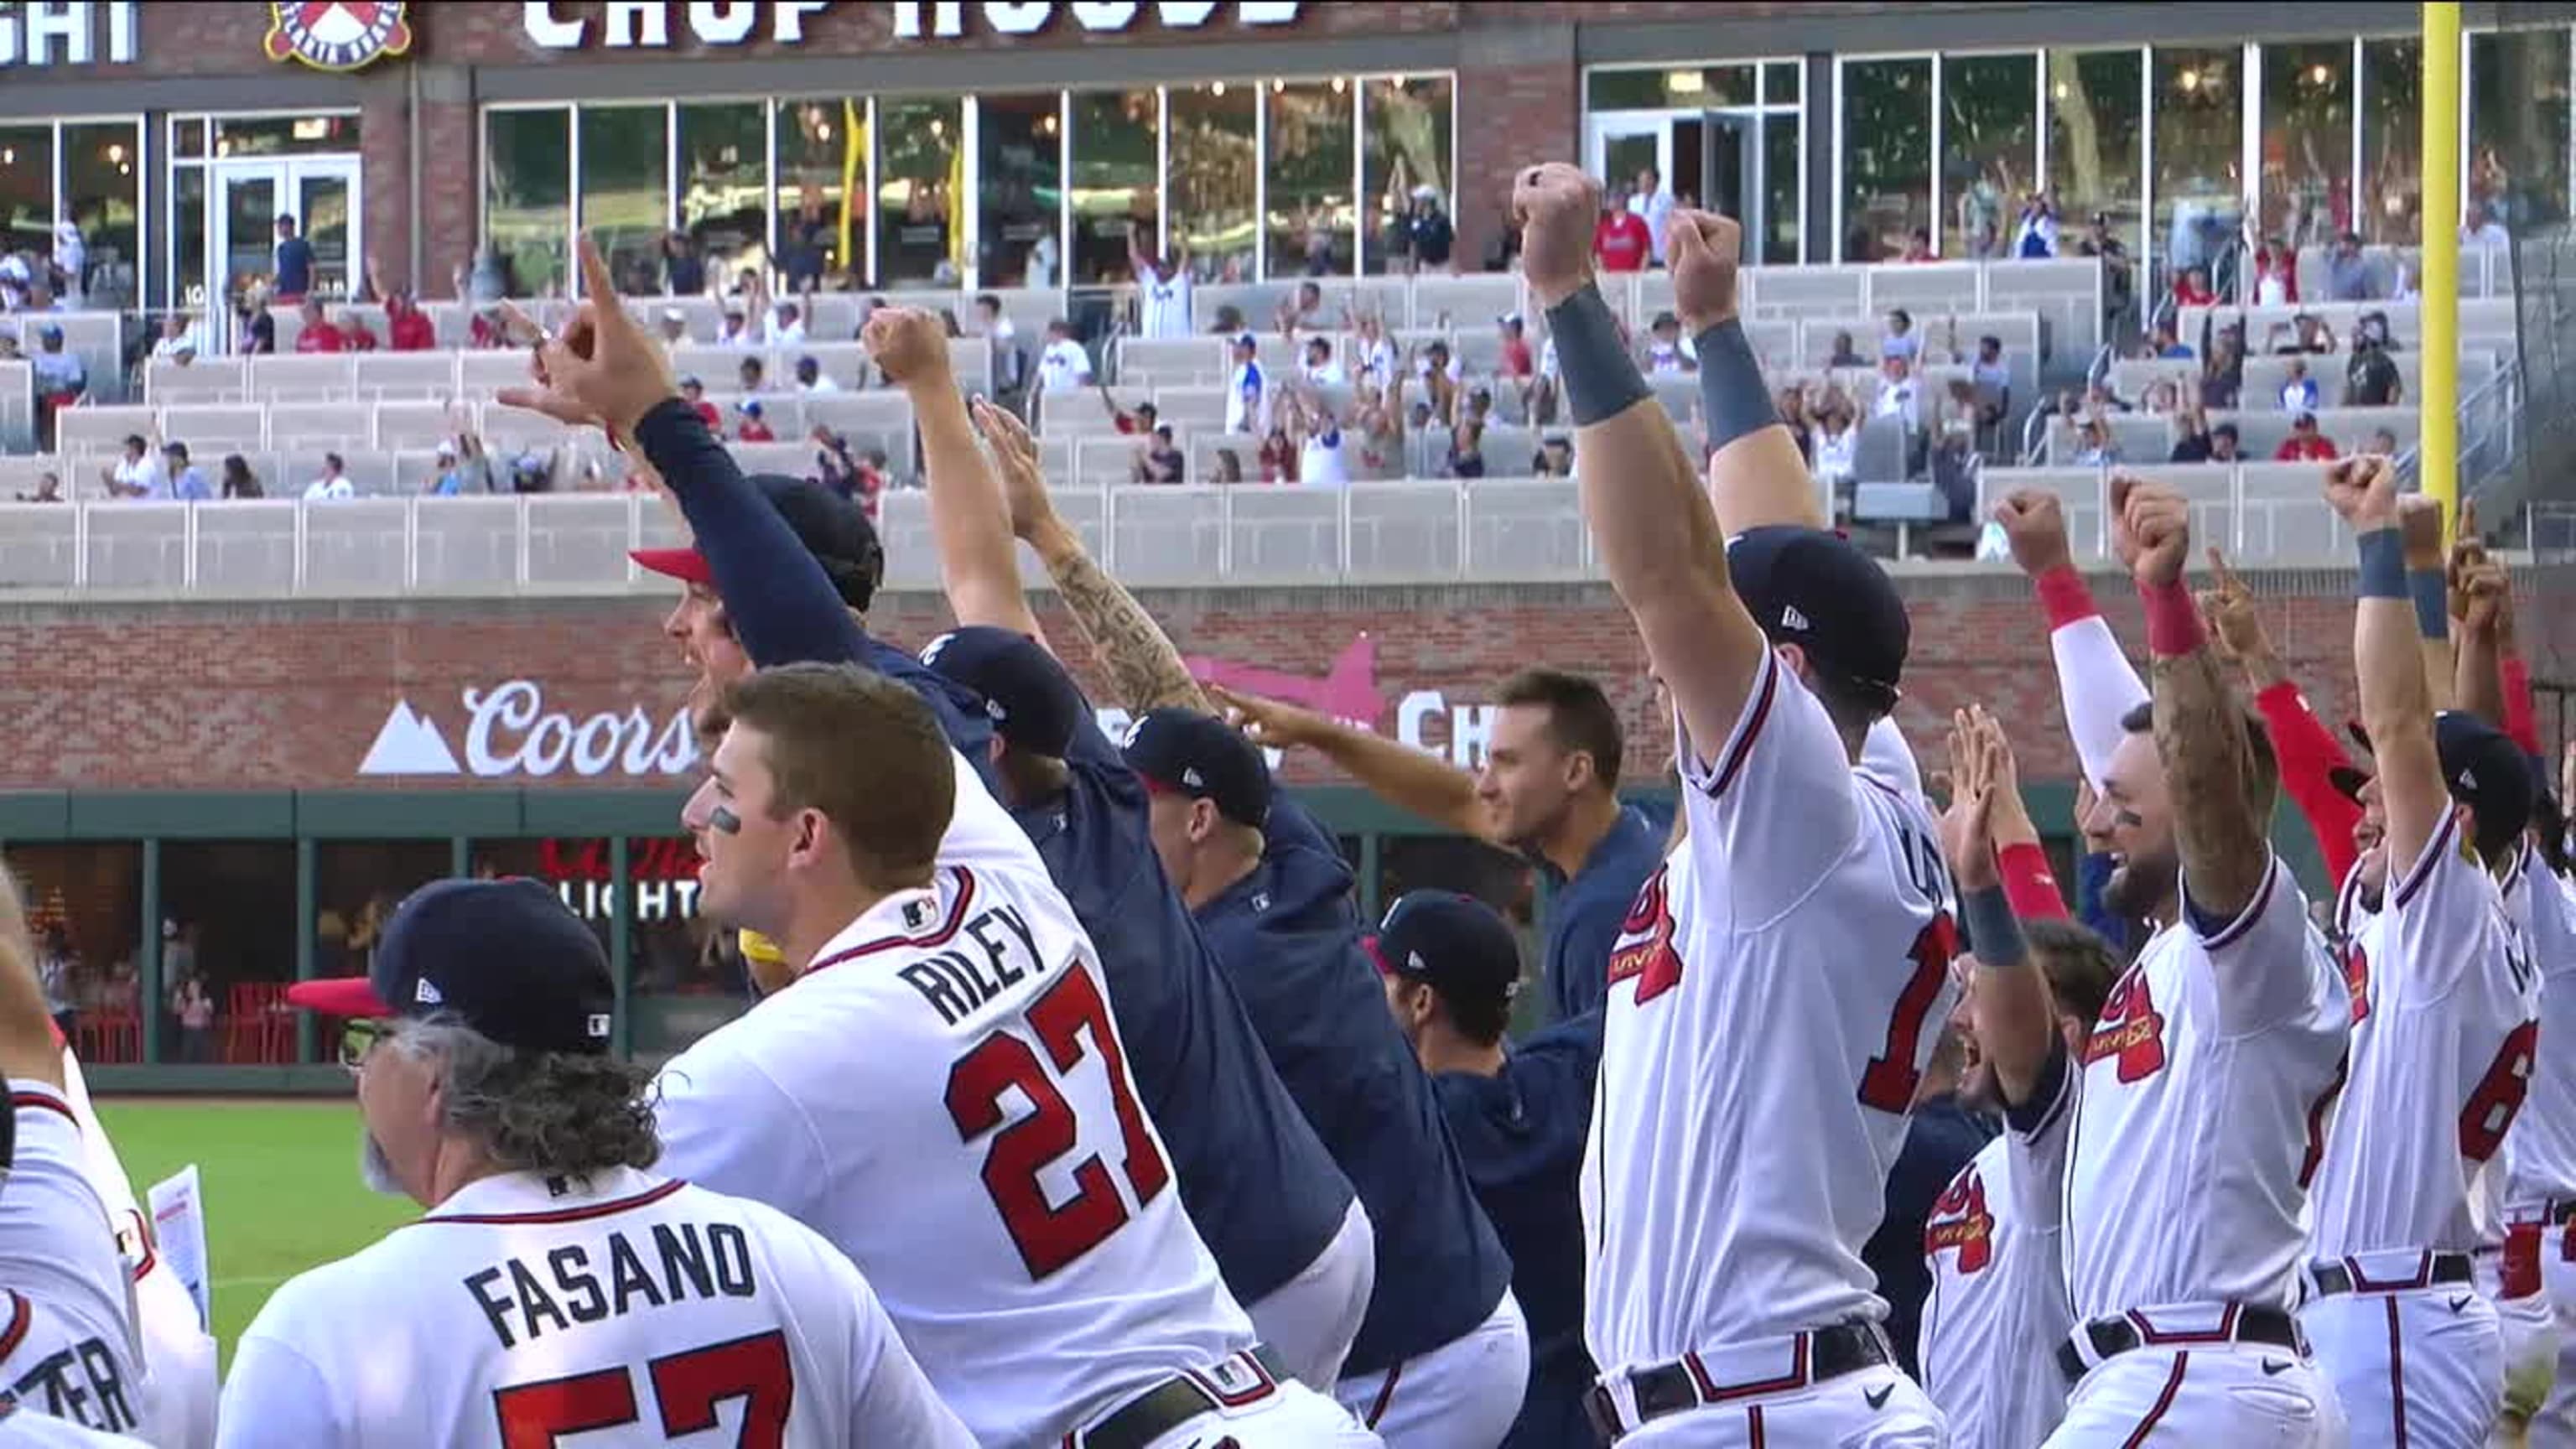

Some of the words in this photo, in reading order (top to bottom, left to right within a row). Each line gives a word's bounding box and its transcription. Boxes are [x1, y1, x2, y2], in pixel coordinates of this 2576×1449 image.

[463, 680, 699, 776] Coors
[896, 904, 1045, 1026] RILEY
[943, 958, 1169, 1281] 27
[463, 1223, 756, 1349] FASANO
[493, 1328, 794, 1449] 57
